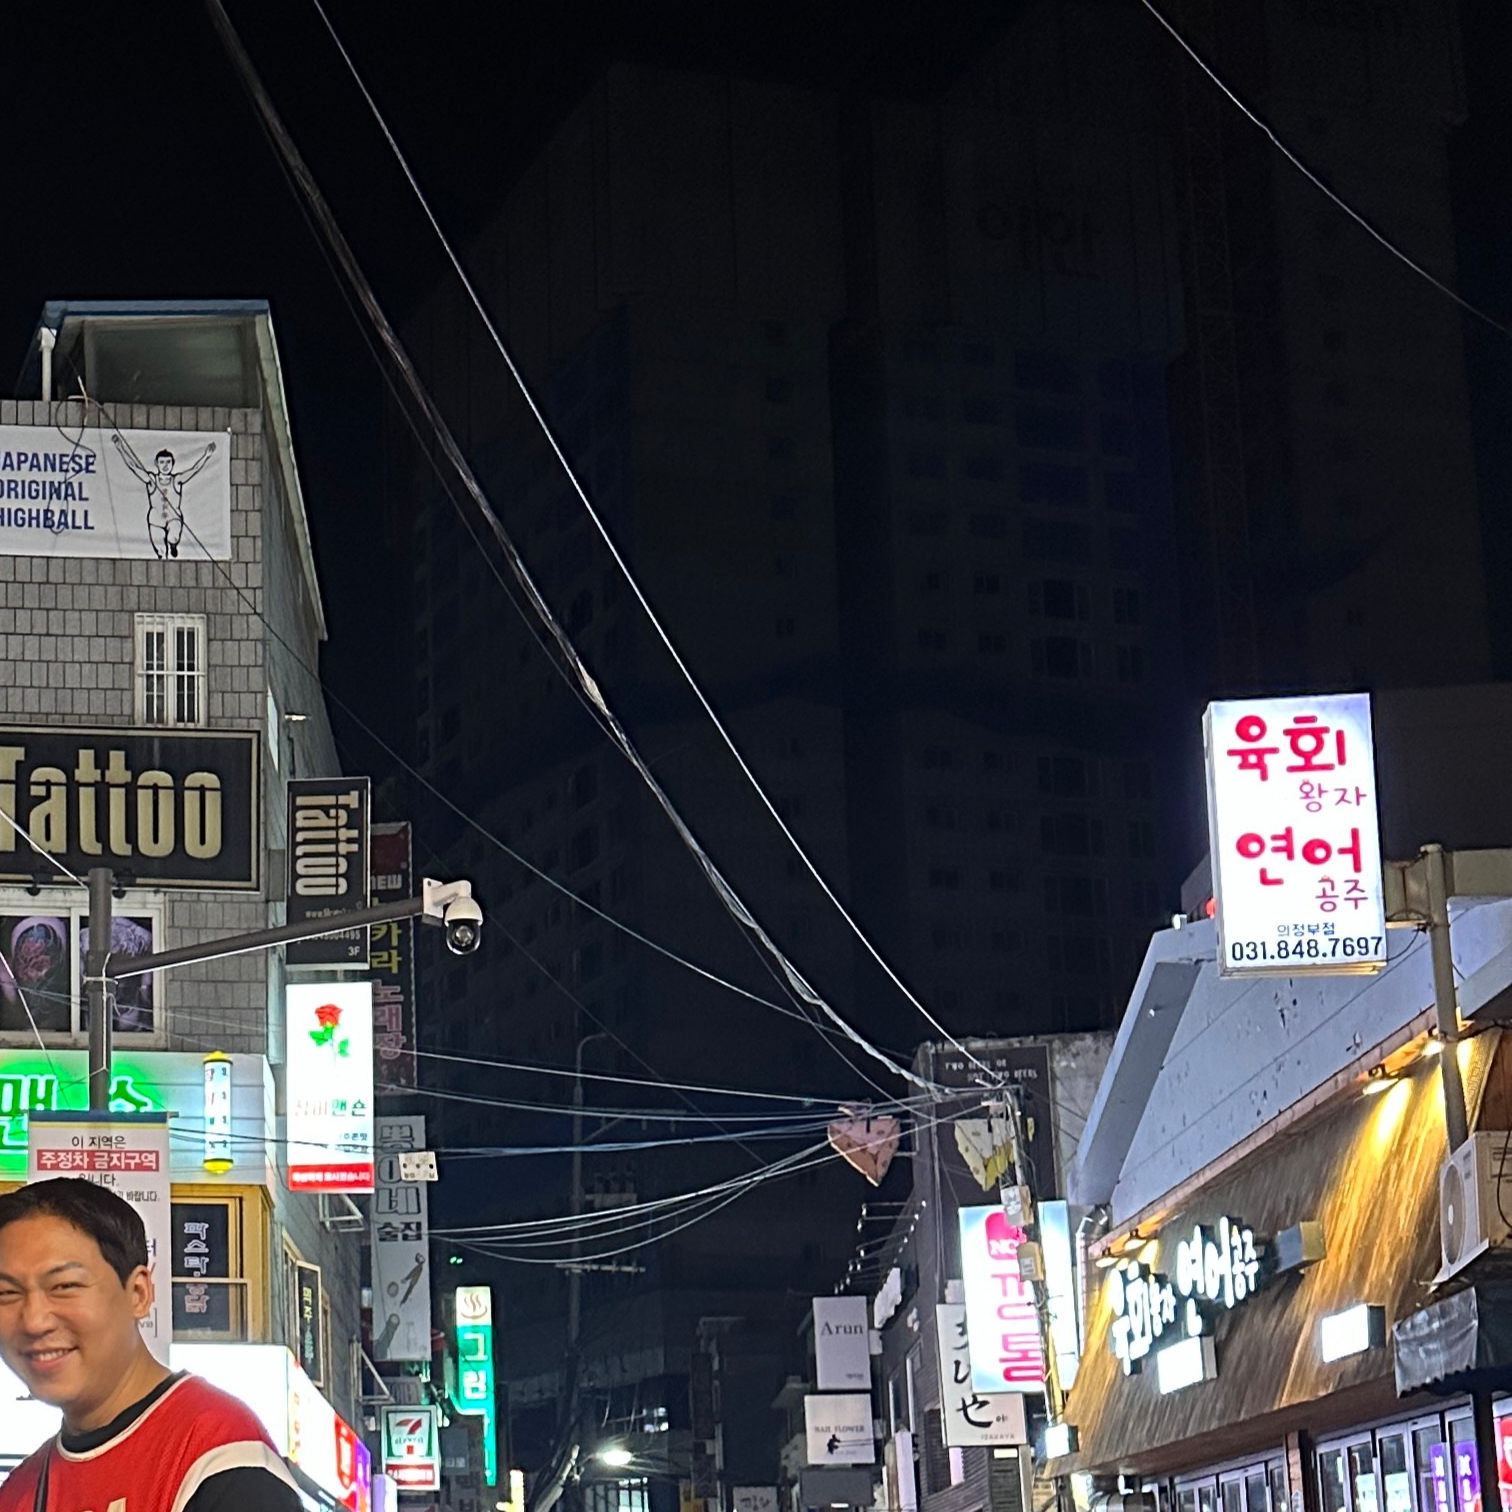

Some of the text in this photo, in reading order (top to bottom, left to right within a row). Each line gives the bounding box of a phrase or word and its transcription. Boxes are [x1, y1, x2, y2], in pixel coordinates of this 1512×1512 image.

[1227, 715, 1346, 781] 육회
[1299, 779, 1367, 812] 왕자
[296, 791, 359, 896] Tattoo
[1236, 826, 1362, 886] 연어
[1315, 876, 1369, 912] 공주
[1277, 922, 1336, 937] 의정부점
[348, 946, 361, 956] 3F
[1231, 935, 1383, 961] 031.848.7697
[71, 1135, 126, 1149] 이 지역은
[40, 1152, 157, 1170] 주정차 금지구역
[821, 1321, 864, 1336] Arun
[462, 1332, 489, 1400] 그린
